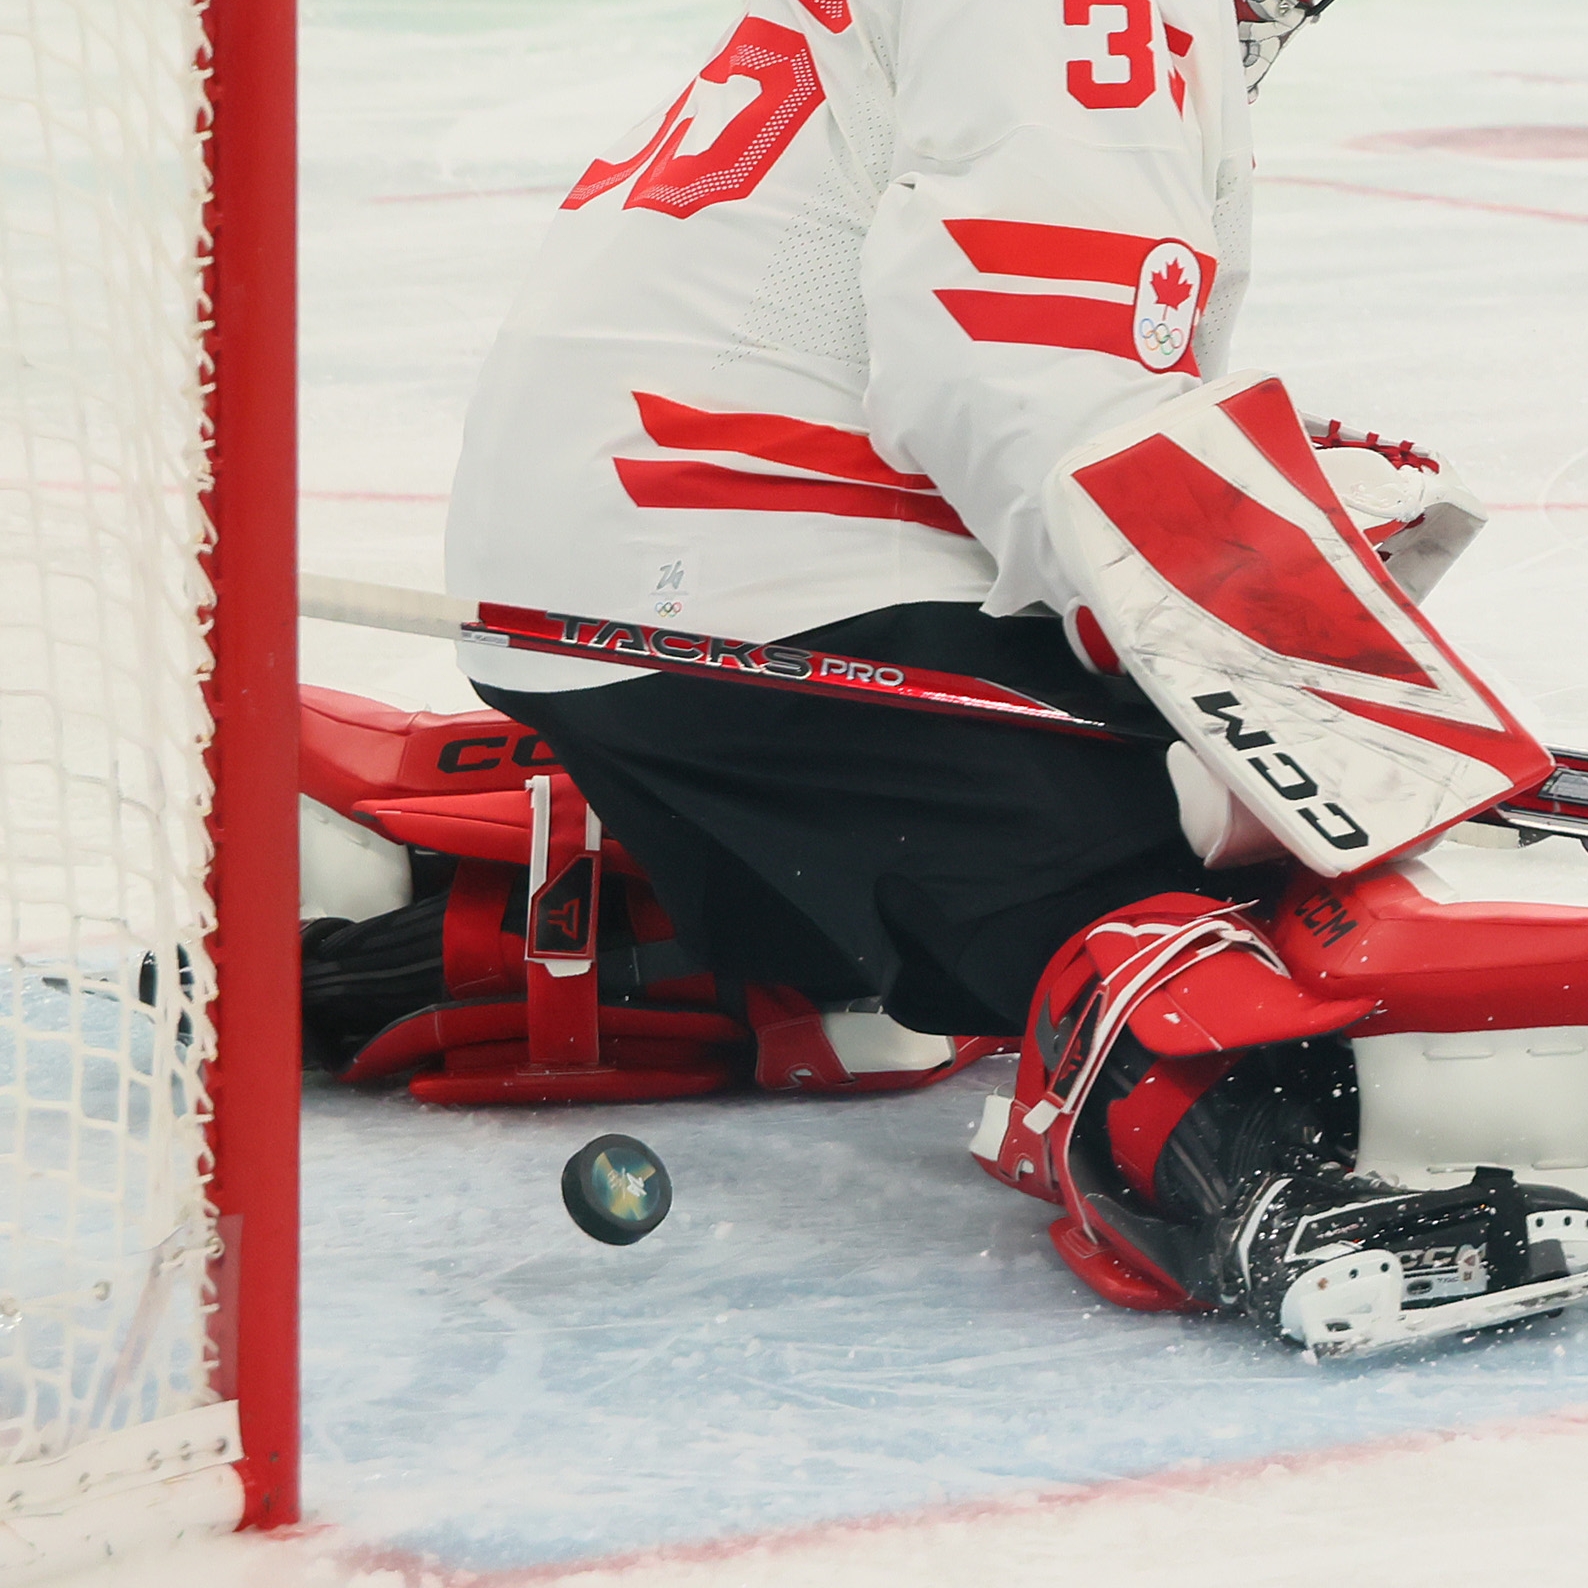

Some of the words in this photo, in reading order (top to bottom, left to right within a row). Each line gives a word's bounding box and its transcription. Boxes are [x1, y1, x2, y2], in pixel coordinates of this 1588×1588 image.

[545, 610, 814, 680] TACKS
[818, 656, 906, 688] PRO
[437, 734, 562, 776] CC
[1192, 689, 1370, 850] CCM
[1293, 887, 1361, 949] CCM
